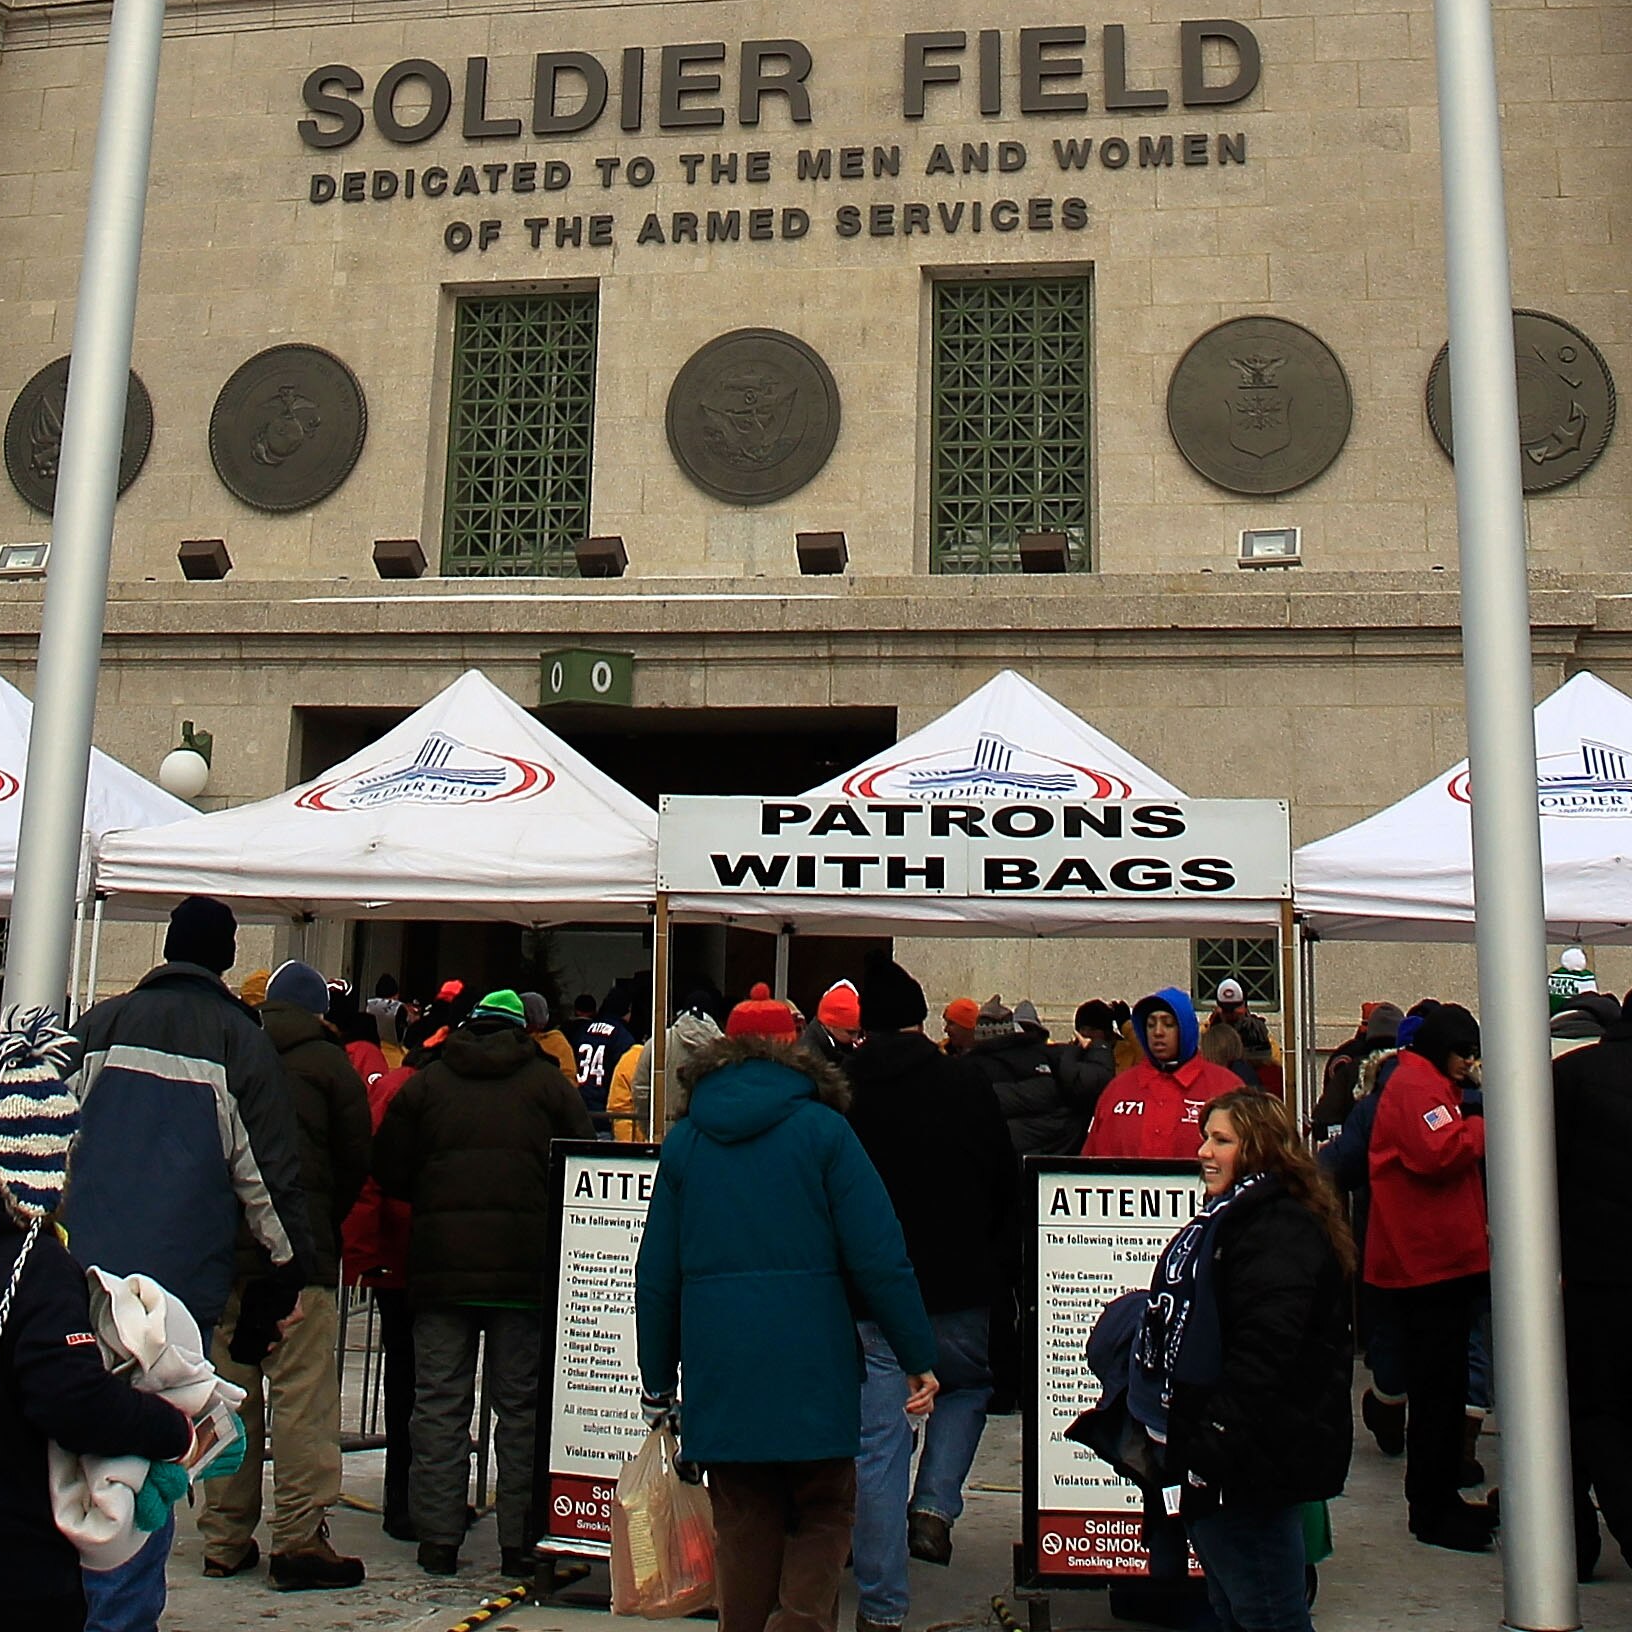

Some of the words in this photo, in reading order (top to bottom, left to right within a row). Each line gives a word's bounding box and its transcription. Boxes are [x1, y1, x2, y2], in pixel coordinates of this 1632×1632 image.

[297, 38, 812, 148] SOLDIER
[904, 18, 1261, 119] FIELD
[309, 160, 571, 204] DEDICATED
[596, 156, 655, 187] TO
[680, 150, 771, 184] THE
[798, 145, 900, 180] MEN
[925, 140, 1028, 176] AND
[1053, 133, 1246, 169] WOMEN
[444, 219, 501, 252] OF
[524, 214, 614, 248] THE
[636, 207, 811, 244] ARMED
[835, 197, 1089, 237] SERVICES
[430, 783, 487, 798] FIELD
[909, 785, 997, 799] SOLDIER
[1540, 795, 1624, 808] OLDIER
[761, 803, 1186, 840] PATRONS
[710, 854, 945, 890] WITH
[984, 856, 1236, 894] BAGS
[576, 1043, 605, 1086] 34
[1113, 1101, 1144, 1115] 471
[574, 1170, 652, 1201] ATTE
[1050, 1187, 1196, 1218] ATTENTI
[570, 1214, 586, 1225] The
[589, 1215, 631, 1230] following
[633, 1219, 647, 1229] ite
[630, 1234, 639, 1243] in
[1046, 1233, 1060, 1245] The
[1067, 1233, 1113, 1247] following
[1116, 1234, 1143, 1246] items
[1146, 1237, 1162, 1246] are
[573, 1250, 594, 1260] Video
[596, 1251, 629, 1262] Cameras
[1113, 1251, 1122, 1262] in
[572, 1263, 607, 1274] Weapons
[609, 1266, 618, 1274] of
[619, 1268, 633, 1276] any
[1052, 1271, 1075, 1280] Video
[1077, 1271, 1113, 1281] Cameras
[571, 1290, 588, 1299] than
[1052, 1284, 1089, 1294] Weapons
[1092, 1285, 1101, 1294] of
[1103, 1287, 1117, 1296] any
[570, 1302, 590, 1313] Flags
[604, 1304, 636, 1315] Poles/S
[1052, 1298, 1092, 1308] Oversized
[570, 1315, 598, 1325] Alcohol
[1052, 1312, 1071, 1321] than
[569, 1329, 590, 1338] Noise
[592, 1330, 621, 1340] Makers
[1052, 1325, 1074, 1335] Flags
[1077, 1327, 1087, 1335] on
[67, 1333, 95, 1344] BEA
[1052, 1339, 1083, 1348] Alcohol
[569, 1341, 592, 1352] Illegal
[594, 1343, 616, 1355] Drugs
[568, 1354, 588, 1364] Laser
[590, 1356, 621, 1367] Pointers
[1052, 1352, 1076, 1361] Noise
[567, 1368, 587, 1377] Other
[590, 1370, 628, 1382] Beverages
[1052, 1366, 1078, 1376] Illegal
[567, 1381, 607, 1392] Containers
[609, 1384, 617, 1393] of
[619, 1385, 633, 1396] Any
[1052, 1380, 1075, 1389] Laser
[1052, 1394, 1075, 1402] Other
[1078, 1394, 1100, 1403] Beve
[563, 1404, 575, 1414] All
[576, 1405, 598, 1417] items
[600, 1407, 628, 1419] carried
[630, 1411, 639, 1419] or
[1053, 1408, 1081, 1417] Contai
[583, 1423, 611, 1436] subject
[613, 1425, 623, 1435] to
[565, 1445, 605, 1459] Violators
[608, 1449, 625, 1461] will
[1073, 1449, 1097, 1461] subje
[1054, 1475, 1099, 1486] Violators
[1103, 1475, 1120, 1486] will
[592, 1485, 614, 1501] Sol
[1126, 1495, 1136, 1503] or
[575, 1501, 597, 1516] NO
[576, 1519, 611, 1533] Smokin
[1085, 1519, 1142, 1535] Soldier
[1065, 1537, 1091, 1552] NO
[1095, 1537, 1150, 1553] SMOK
[1068, 1556, 1113, 1569] Smoking
[1116, 1556, 1147, 1569] Policy
